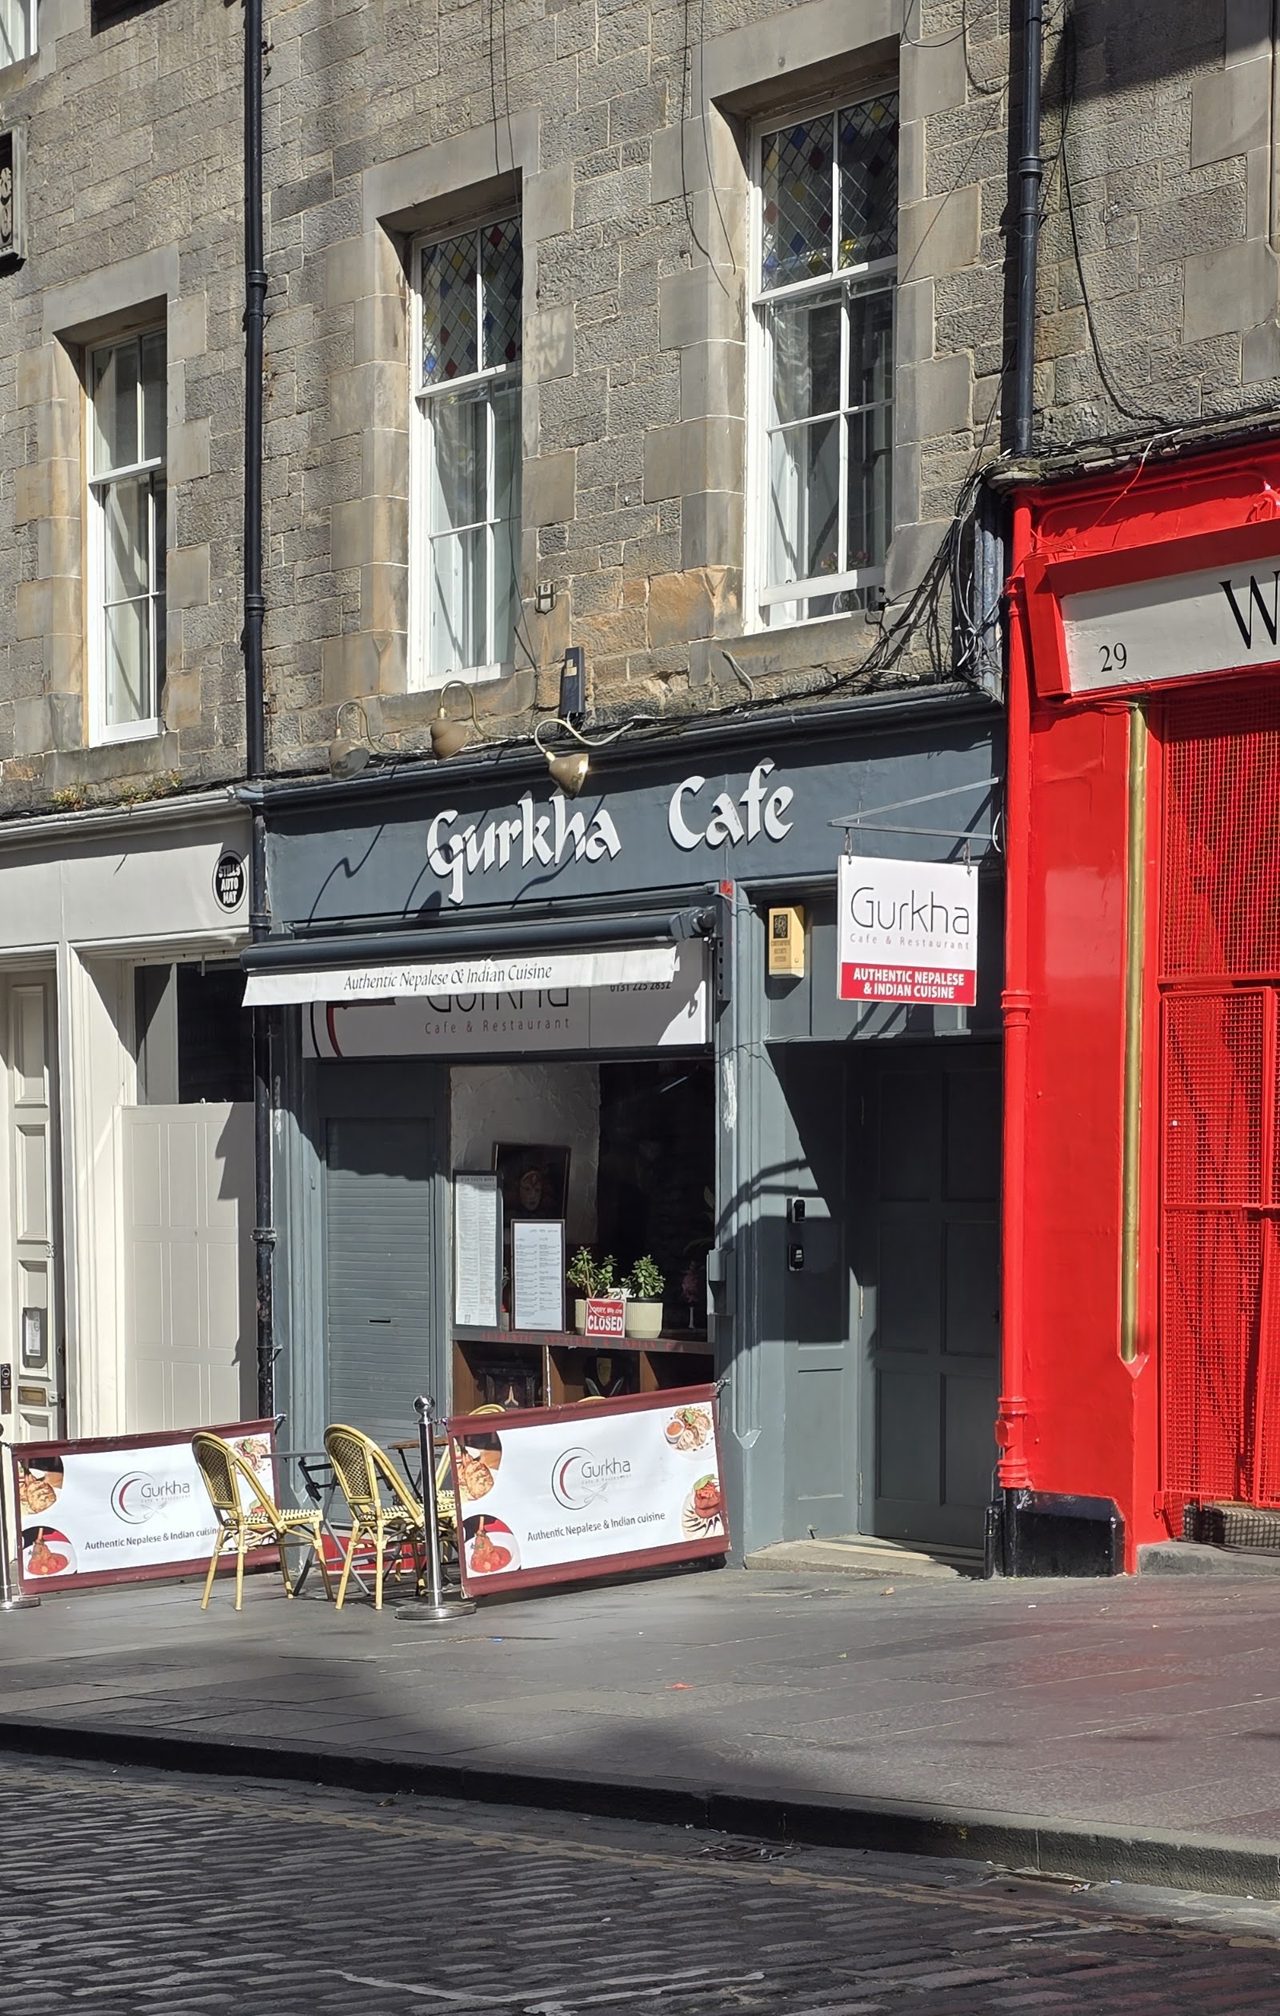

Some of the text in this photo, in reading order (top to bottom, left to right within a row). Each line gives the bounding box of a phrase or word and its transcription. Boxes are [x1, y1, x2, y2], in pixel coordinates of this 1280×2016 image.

[1099, 642, 1127, 672] 29
[427, 757, 794, 904] Gurkha Cafe
[851, 887, 969, 934] Gurkha
[850, 933, 877, 944] Cafe
[901, 938, 969, 950] Restaurant
[344, 963, 552, 991] Authentic Nepalese & Indian Cuisine
[854, 967, 965, 986] AUTHENTIC NEPALESE
[864, 982, 955, 999] & INDIAN CUISINE
[425, 1018, 569, 1034] Cafe & Restaurant
[588, 1315, 623, 1331] CLOSED
[581, 1457, 631, 1478] Gurkha
[141, 1480, 190, 1498] Gurkha
[527, 1511, 666, 1541] Authentic Nepalese & Indian cuisine
[85, 1538, 124, 1550] Authentic
[126, 1534, 161, 1546] Nepalese
[163, 1532, 169, 1541] &
[170, 1529, 195, 1540] Indian
